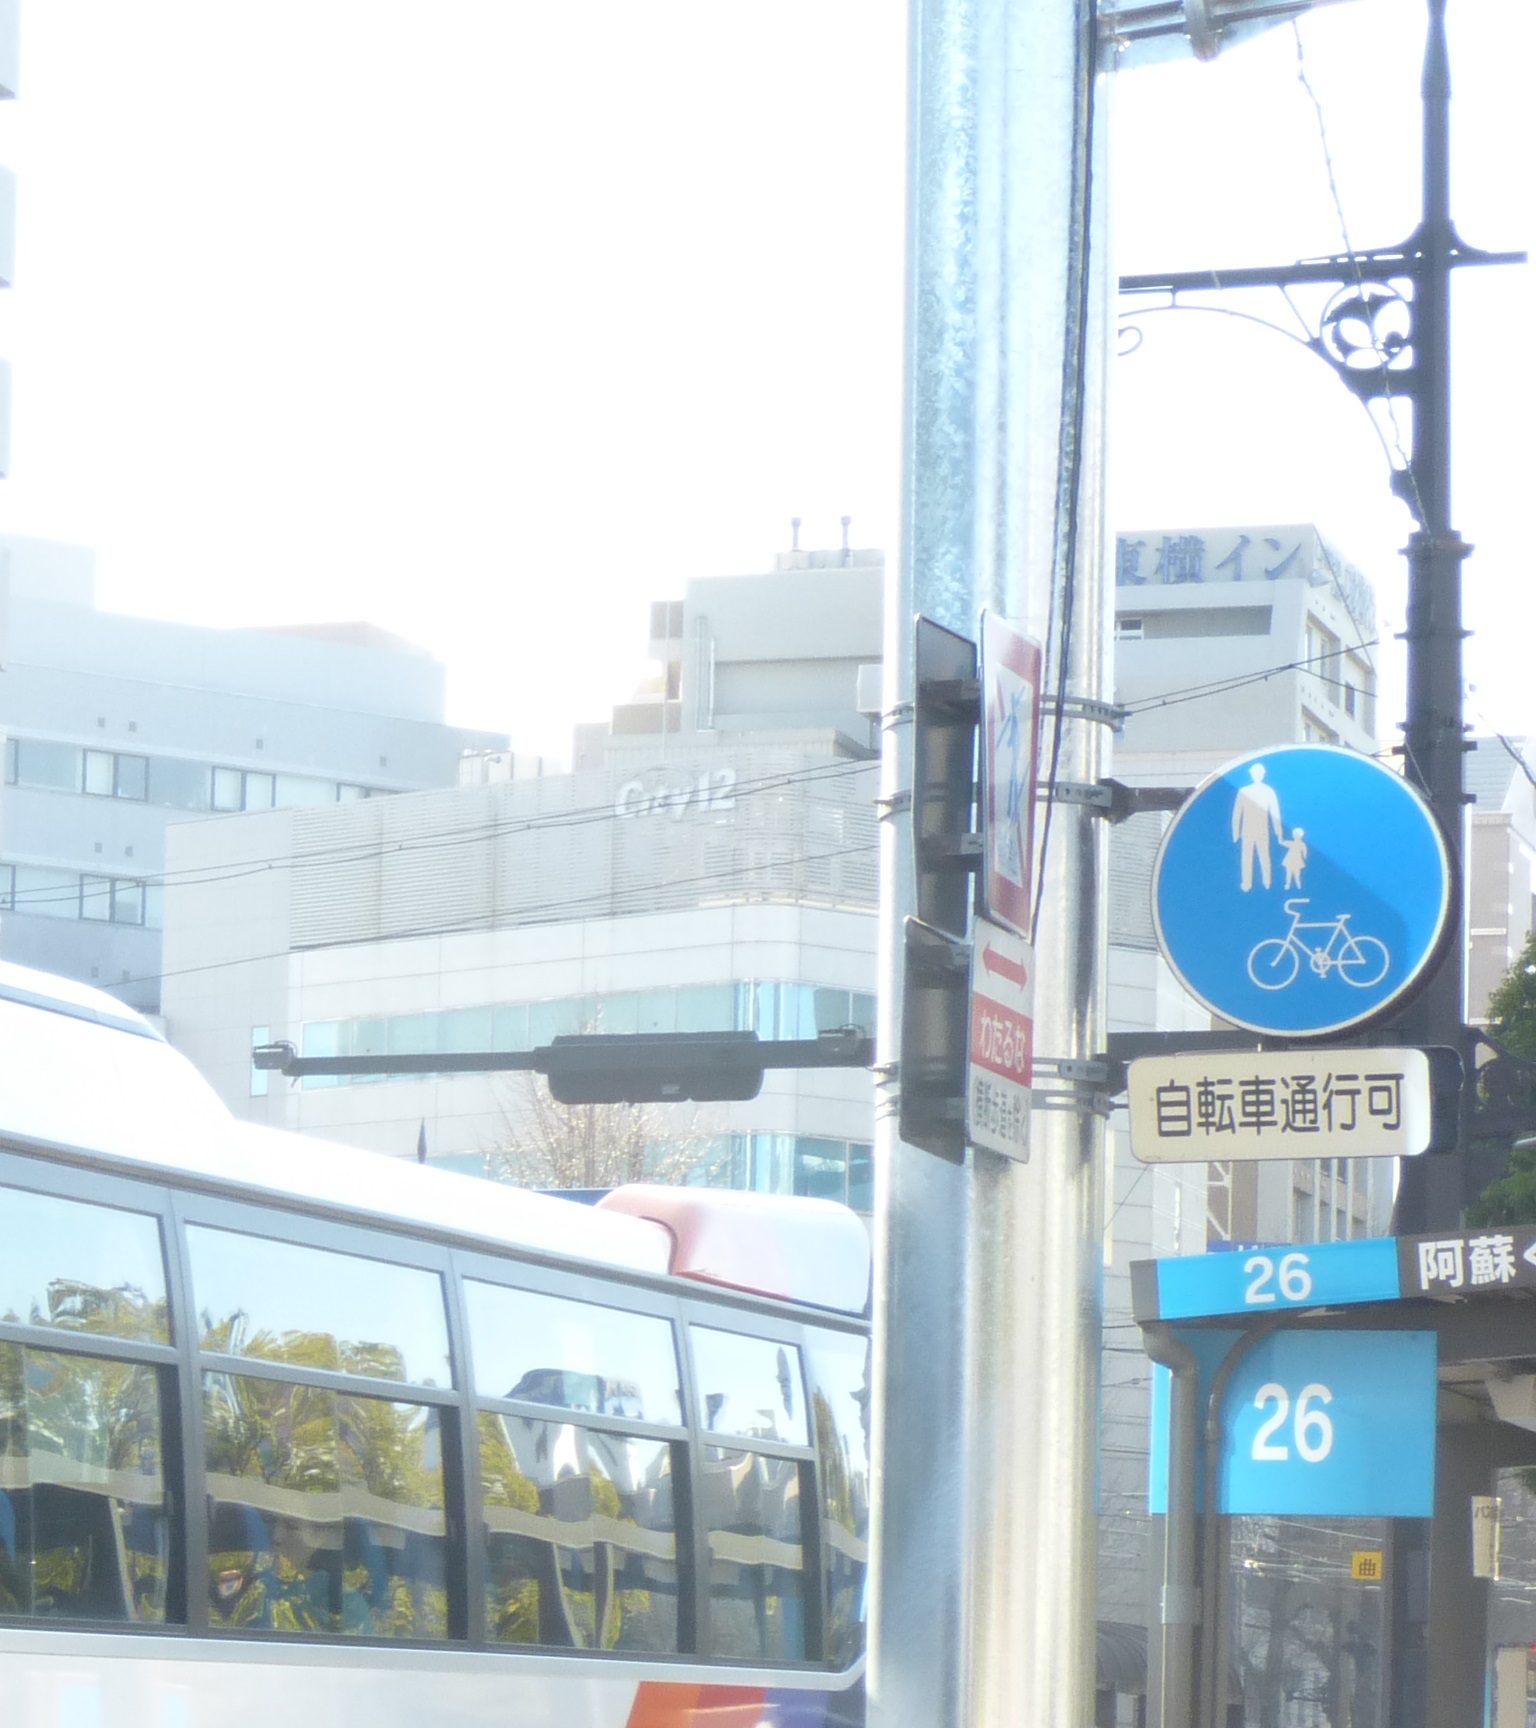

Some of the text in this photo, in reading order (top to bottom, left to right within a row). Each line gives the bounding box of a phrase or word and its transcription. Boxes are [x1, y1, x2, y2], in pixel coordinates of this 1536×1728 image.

[979, 1008, 1027, 1074] わたるな
[1154, 1073, 1405, 1137] 自転車通行可
[1243, 1252, 1313, 1304] 26
[1250, 1381, 1335, 1464] 26
